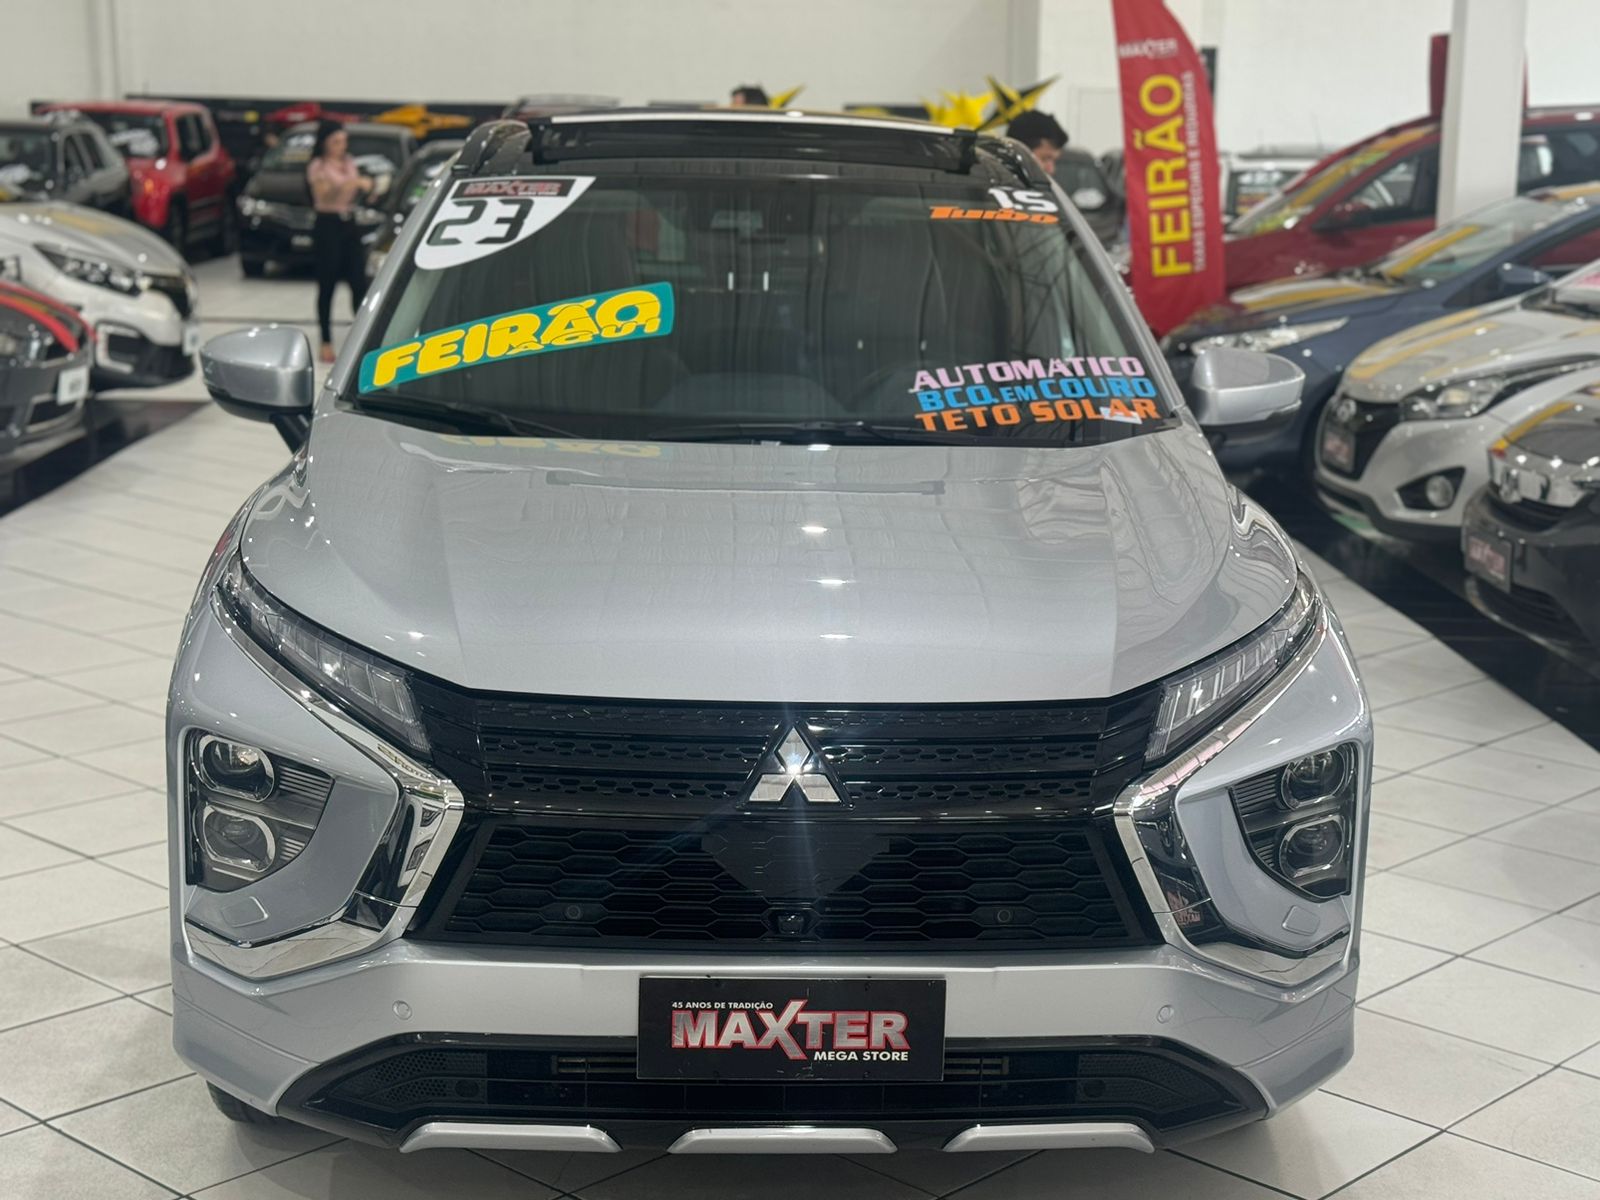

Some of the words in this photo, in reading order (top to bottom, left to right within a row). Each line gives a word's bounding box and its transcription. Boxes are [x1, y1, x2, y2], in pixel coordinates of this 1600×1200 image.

[1134, 74, 1193, 277] FEIRÃO
[426, 198, 534, 247] 23
[929, 206, 1059, 224] Turbo
[373, 290, 661, 386] FEIRÃO
[999, 384, 1038, 402] EM
[1039, 377, 1157, 399] COURO
[915, 404, 1021, 431] TETO
[1030, 398, 1162, 422] SOLAR
[672, 1001, 684, 1009] 45
[685, 1001, 712, 1009] ANOS
[728, 1001, 774, 1010] TRADIÇÃO
[671, 999, 911, 1059] MAXTER
[814, 1051, 858, 1061] MEGA
[862, 1051, 909, 1061] STORE
